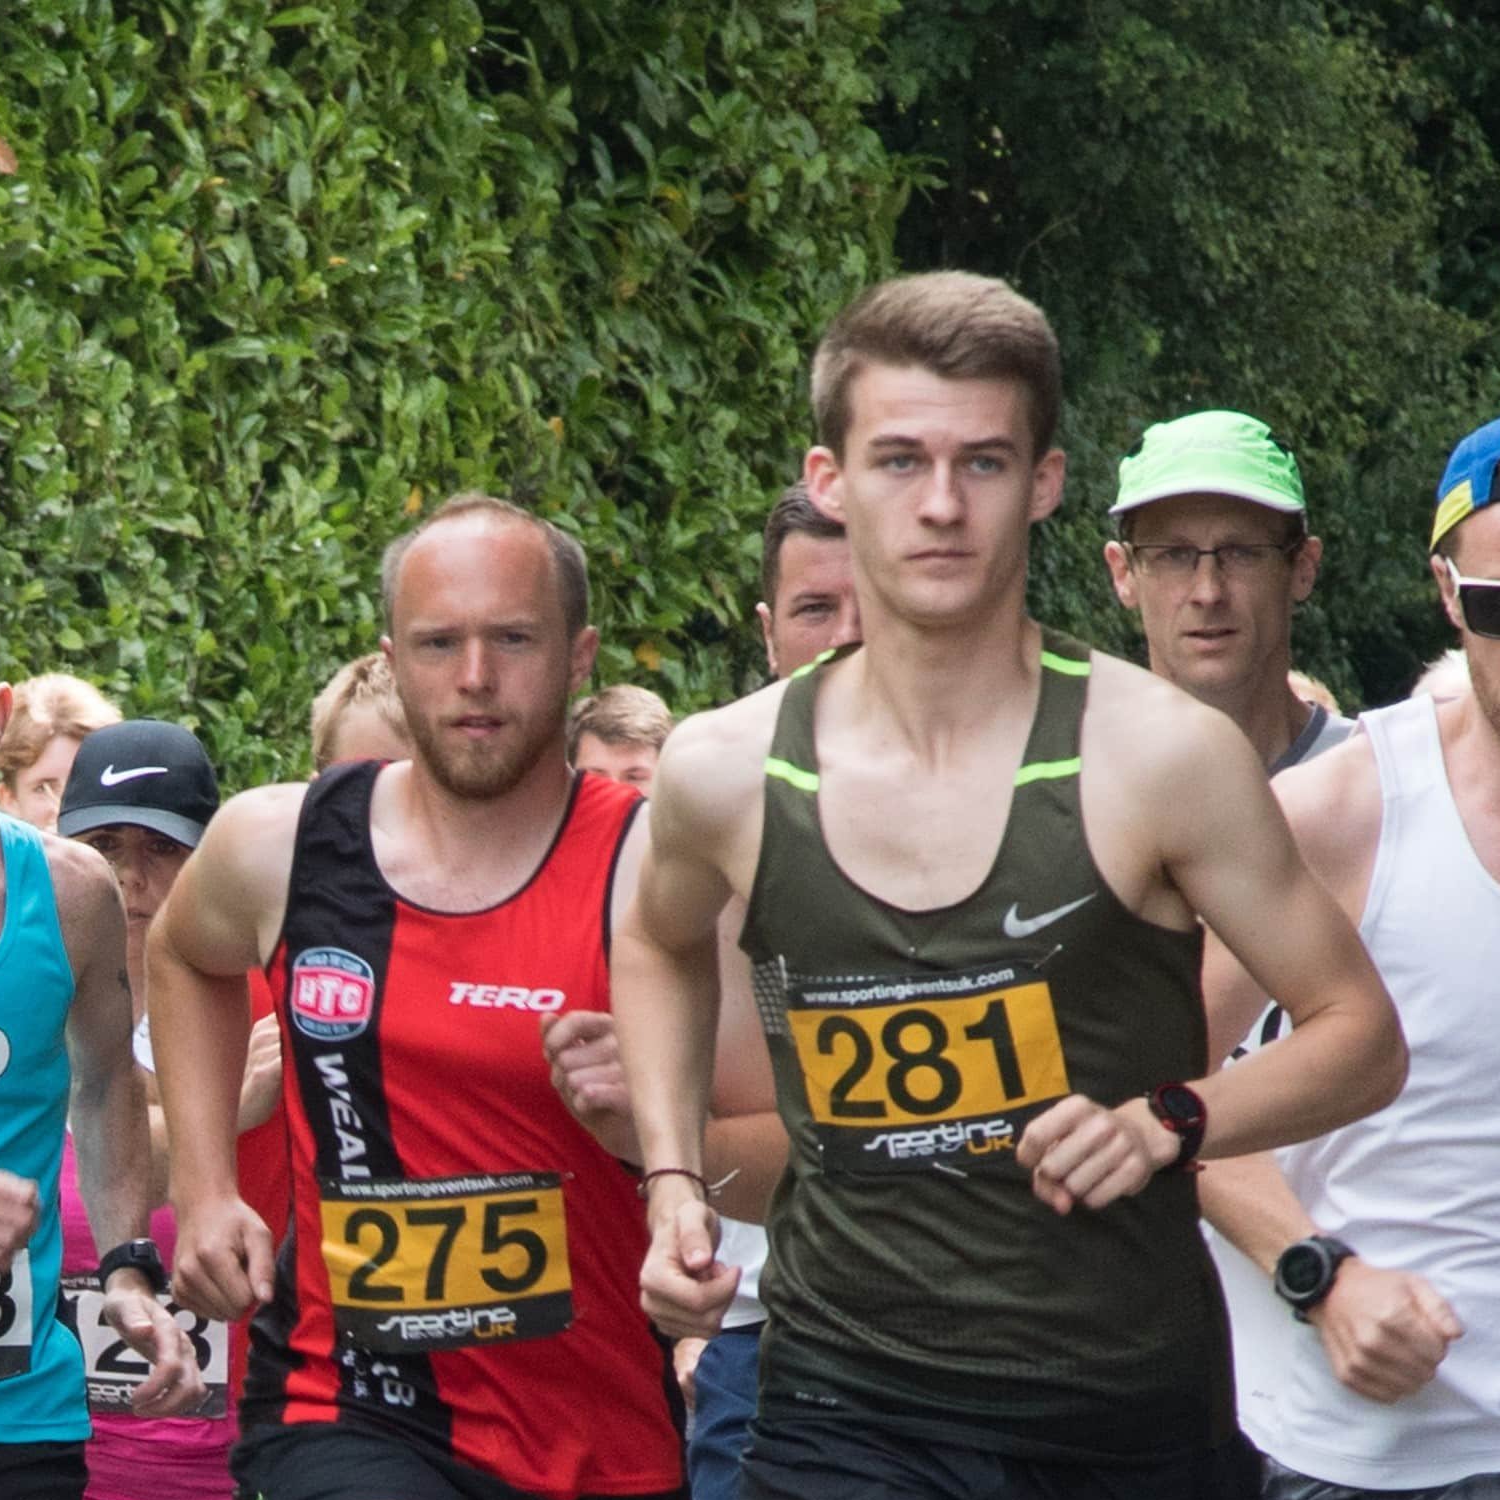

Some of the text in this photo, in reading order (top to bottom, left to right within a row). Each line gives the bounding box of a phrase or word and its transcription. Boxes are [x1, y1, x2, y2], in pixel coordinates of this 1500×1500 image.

[803, 968, 1015, 1006] www.sportingeventsuk.com
[816, 998, 1027, 1119] 281
[313, 1053, 372, 1182] WEAL
[864, 1119, 1014, 1159] sporting
[967, 1134, 1015, 1155] UK
[340, 1173, 535, 1198] www.sportingeventsuk.com
[344, 1199, 548, 1303] 275
[377, 1306, 517, 1340] sporting
[473, 1320, 518, 1339] UK
